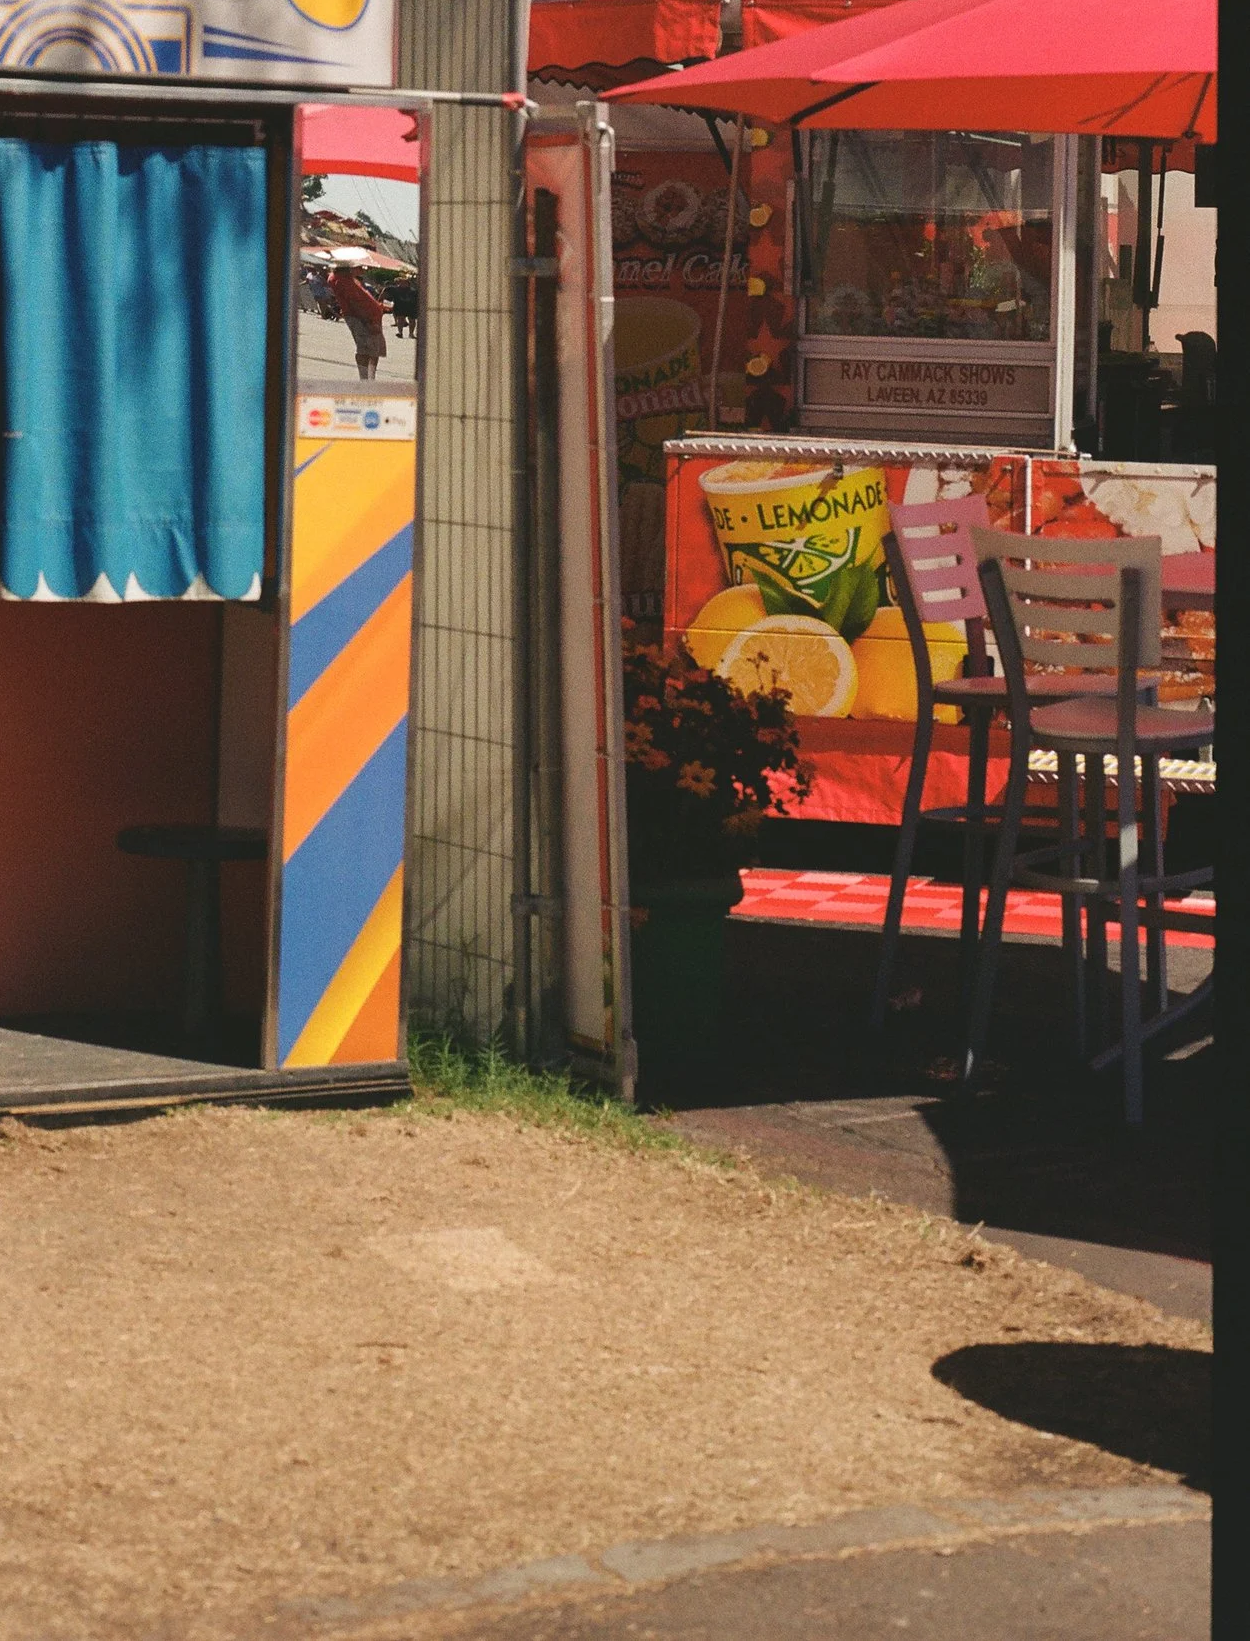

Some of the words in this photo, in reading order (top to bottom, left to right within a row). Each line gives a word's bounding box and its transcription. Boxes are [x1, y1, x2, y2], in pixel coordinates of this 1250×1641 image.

[841, 363, 872, 380] RAY
[876, 364, 954, 384] CAMMACK
[959, 367, 1016, 385] SHOWS
[926, 389, 947, 404] AZ
[756, 480, 884, 531] LEMONADE
